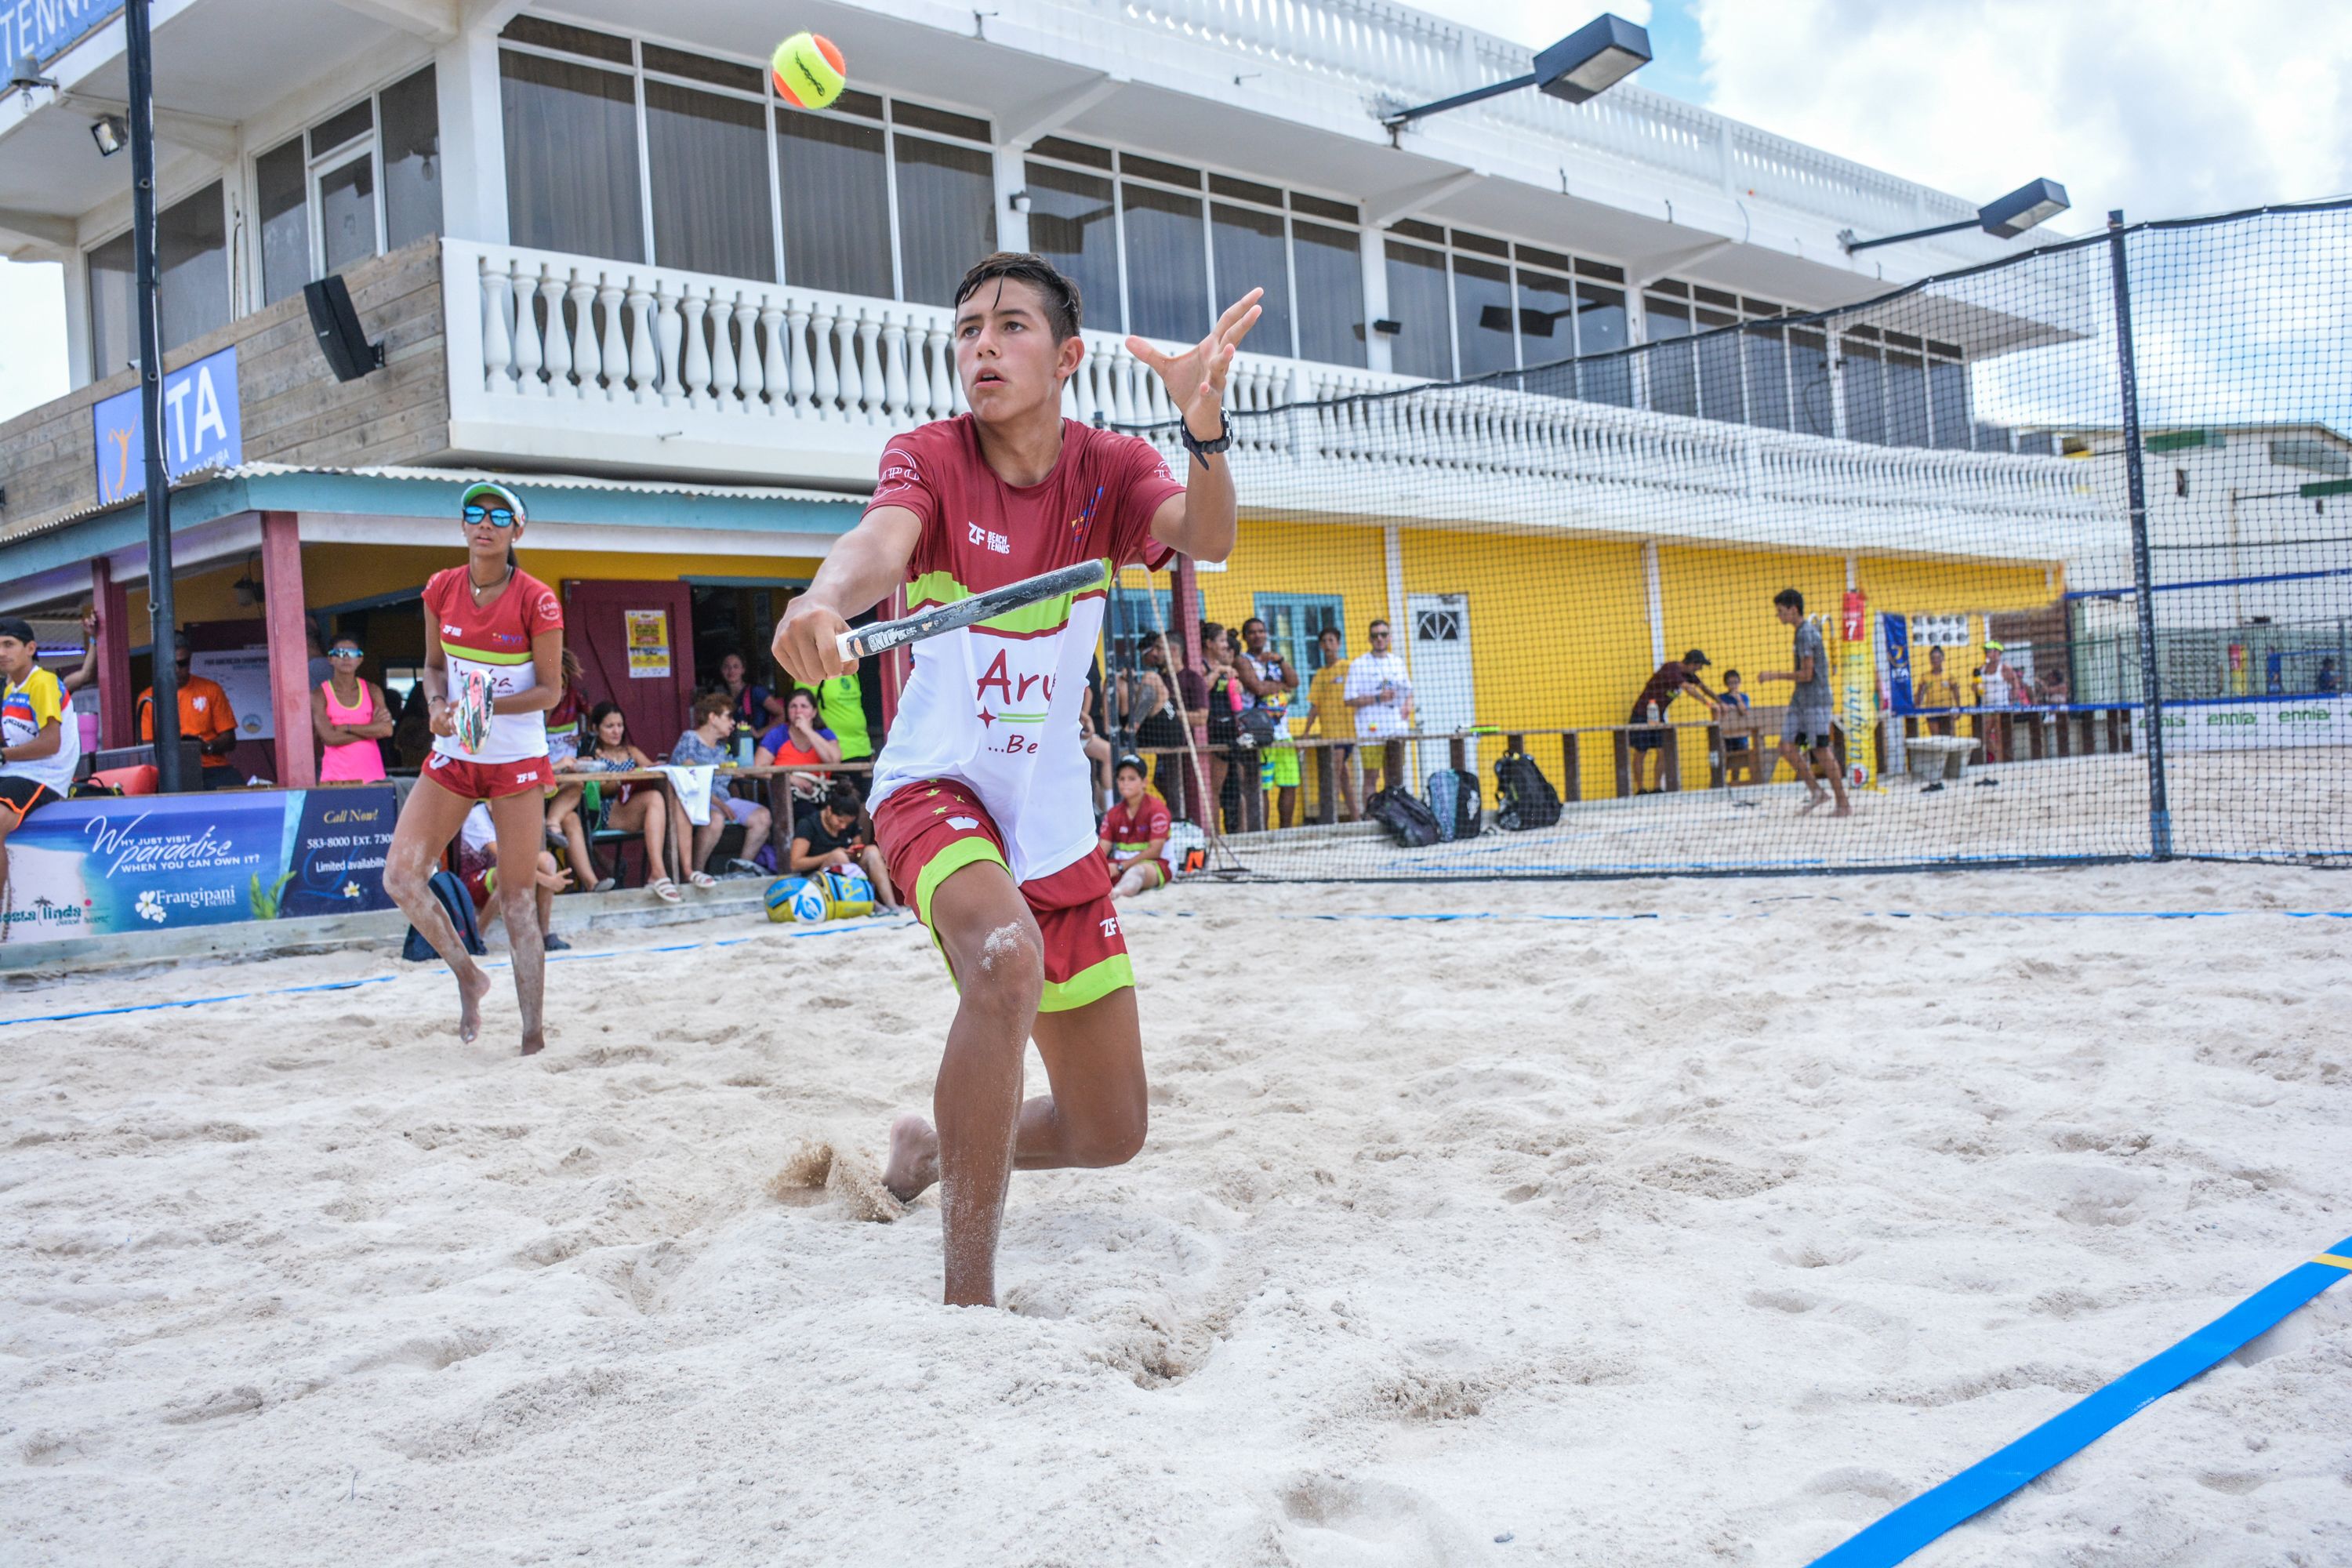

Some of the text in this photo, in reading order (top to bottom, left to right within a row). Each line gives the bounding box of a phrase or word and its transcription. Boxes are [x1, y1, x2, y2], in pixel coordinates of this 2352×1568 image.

[166, 366, 227, 463] TA
[968, 521, 985, 546] ZF
[988, 531, 1007, 546] BEACH
[987, 540, 1011, 554] TENNIS
[977, 648, 1056, 705] Aru
[2206, 710, 2257, 726] ennia
[2278, 706, 2331, 722] ennia
[323, 810, 347, 824] Call
[138, 837, 163, 846] JUST
[165, 835, 192, 844] VISIT
[307, 836, 350, 849] 583-8000
[106, 826, 232, 879] paradise
[121, 854, 260, 873] WHEN YOU CAN OWN IT?
[315, 861, 346, 873] Limited
[156, 884, 235, 908] Frangipani
[0, 910, 36, 924] osta
[43, 905, 82, 920] linda
